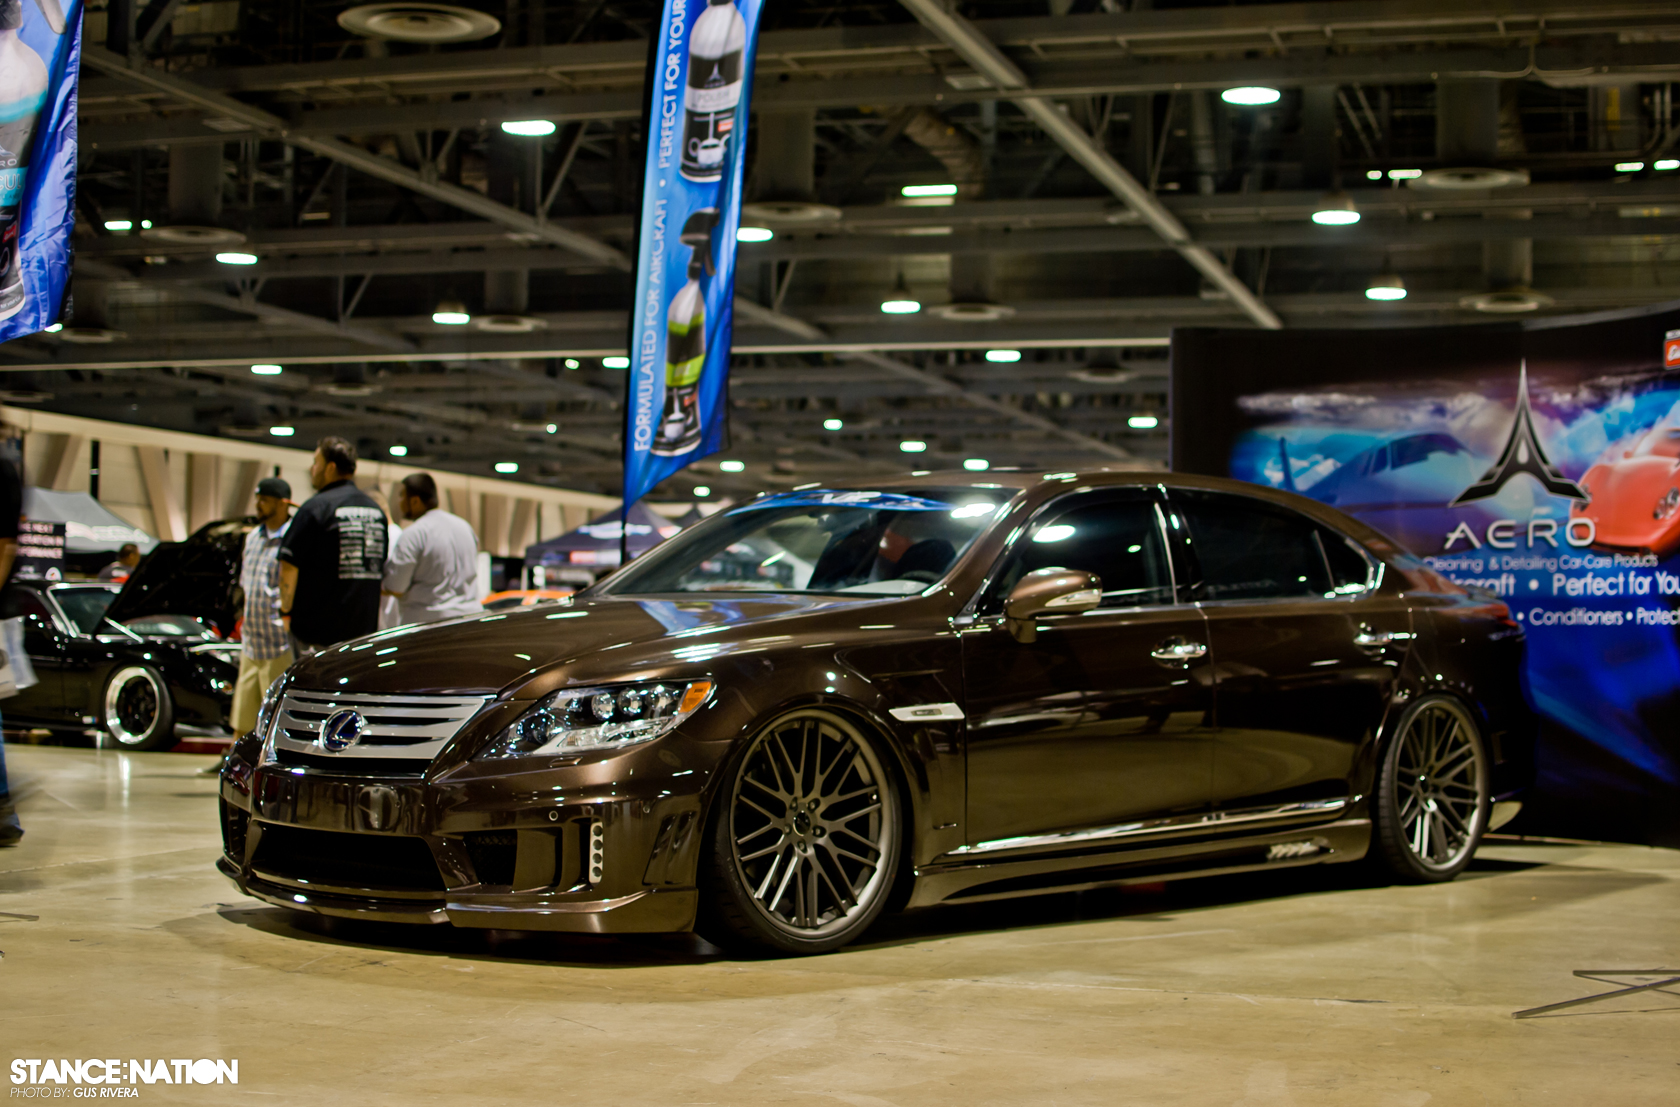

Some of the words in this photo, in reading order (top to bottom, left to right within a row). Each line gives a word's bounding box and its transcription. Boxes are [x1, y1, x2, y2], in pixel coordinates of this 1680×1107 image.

[669, 0, 687, 50] YOUR
[664, 52, 682, 91] FOR
[658, 94, 677, 169] PERFECT
[648, 198, 668, 285] AIRCRAFT
[644, 289, 660, 326] FOR
[634, 330, 657, 451] FORMULATED
[1444, 517, 1596, 549] AERO
[1423, 556, 1484, 574] Cleaning
[1489, 556, 1499, 571] &
[1502, 555, 1558, 573] Detailing
[1613, 553, 1659, 568] Products
[1553, 572, 1625, 596] Perfect
[1629, 570, 1653, 595] for
[1529, 607, 1624, 626] Conditioners
